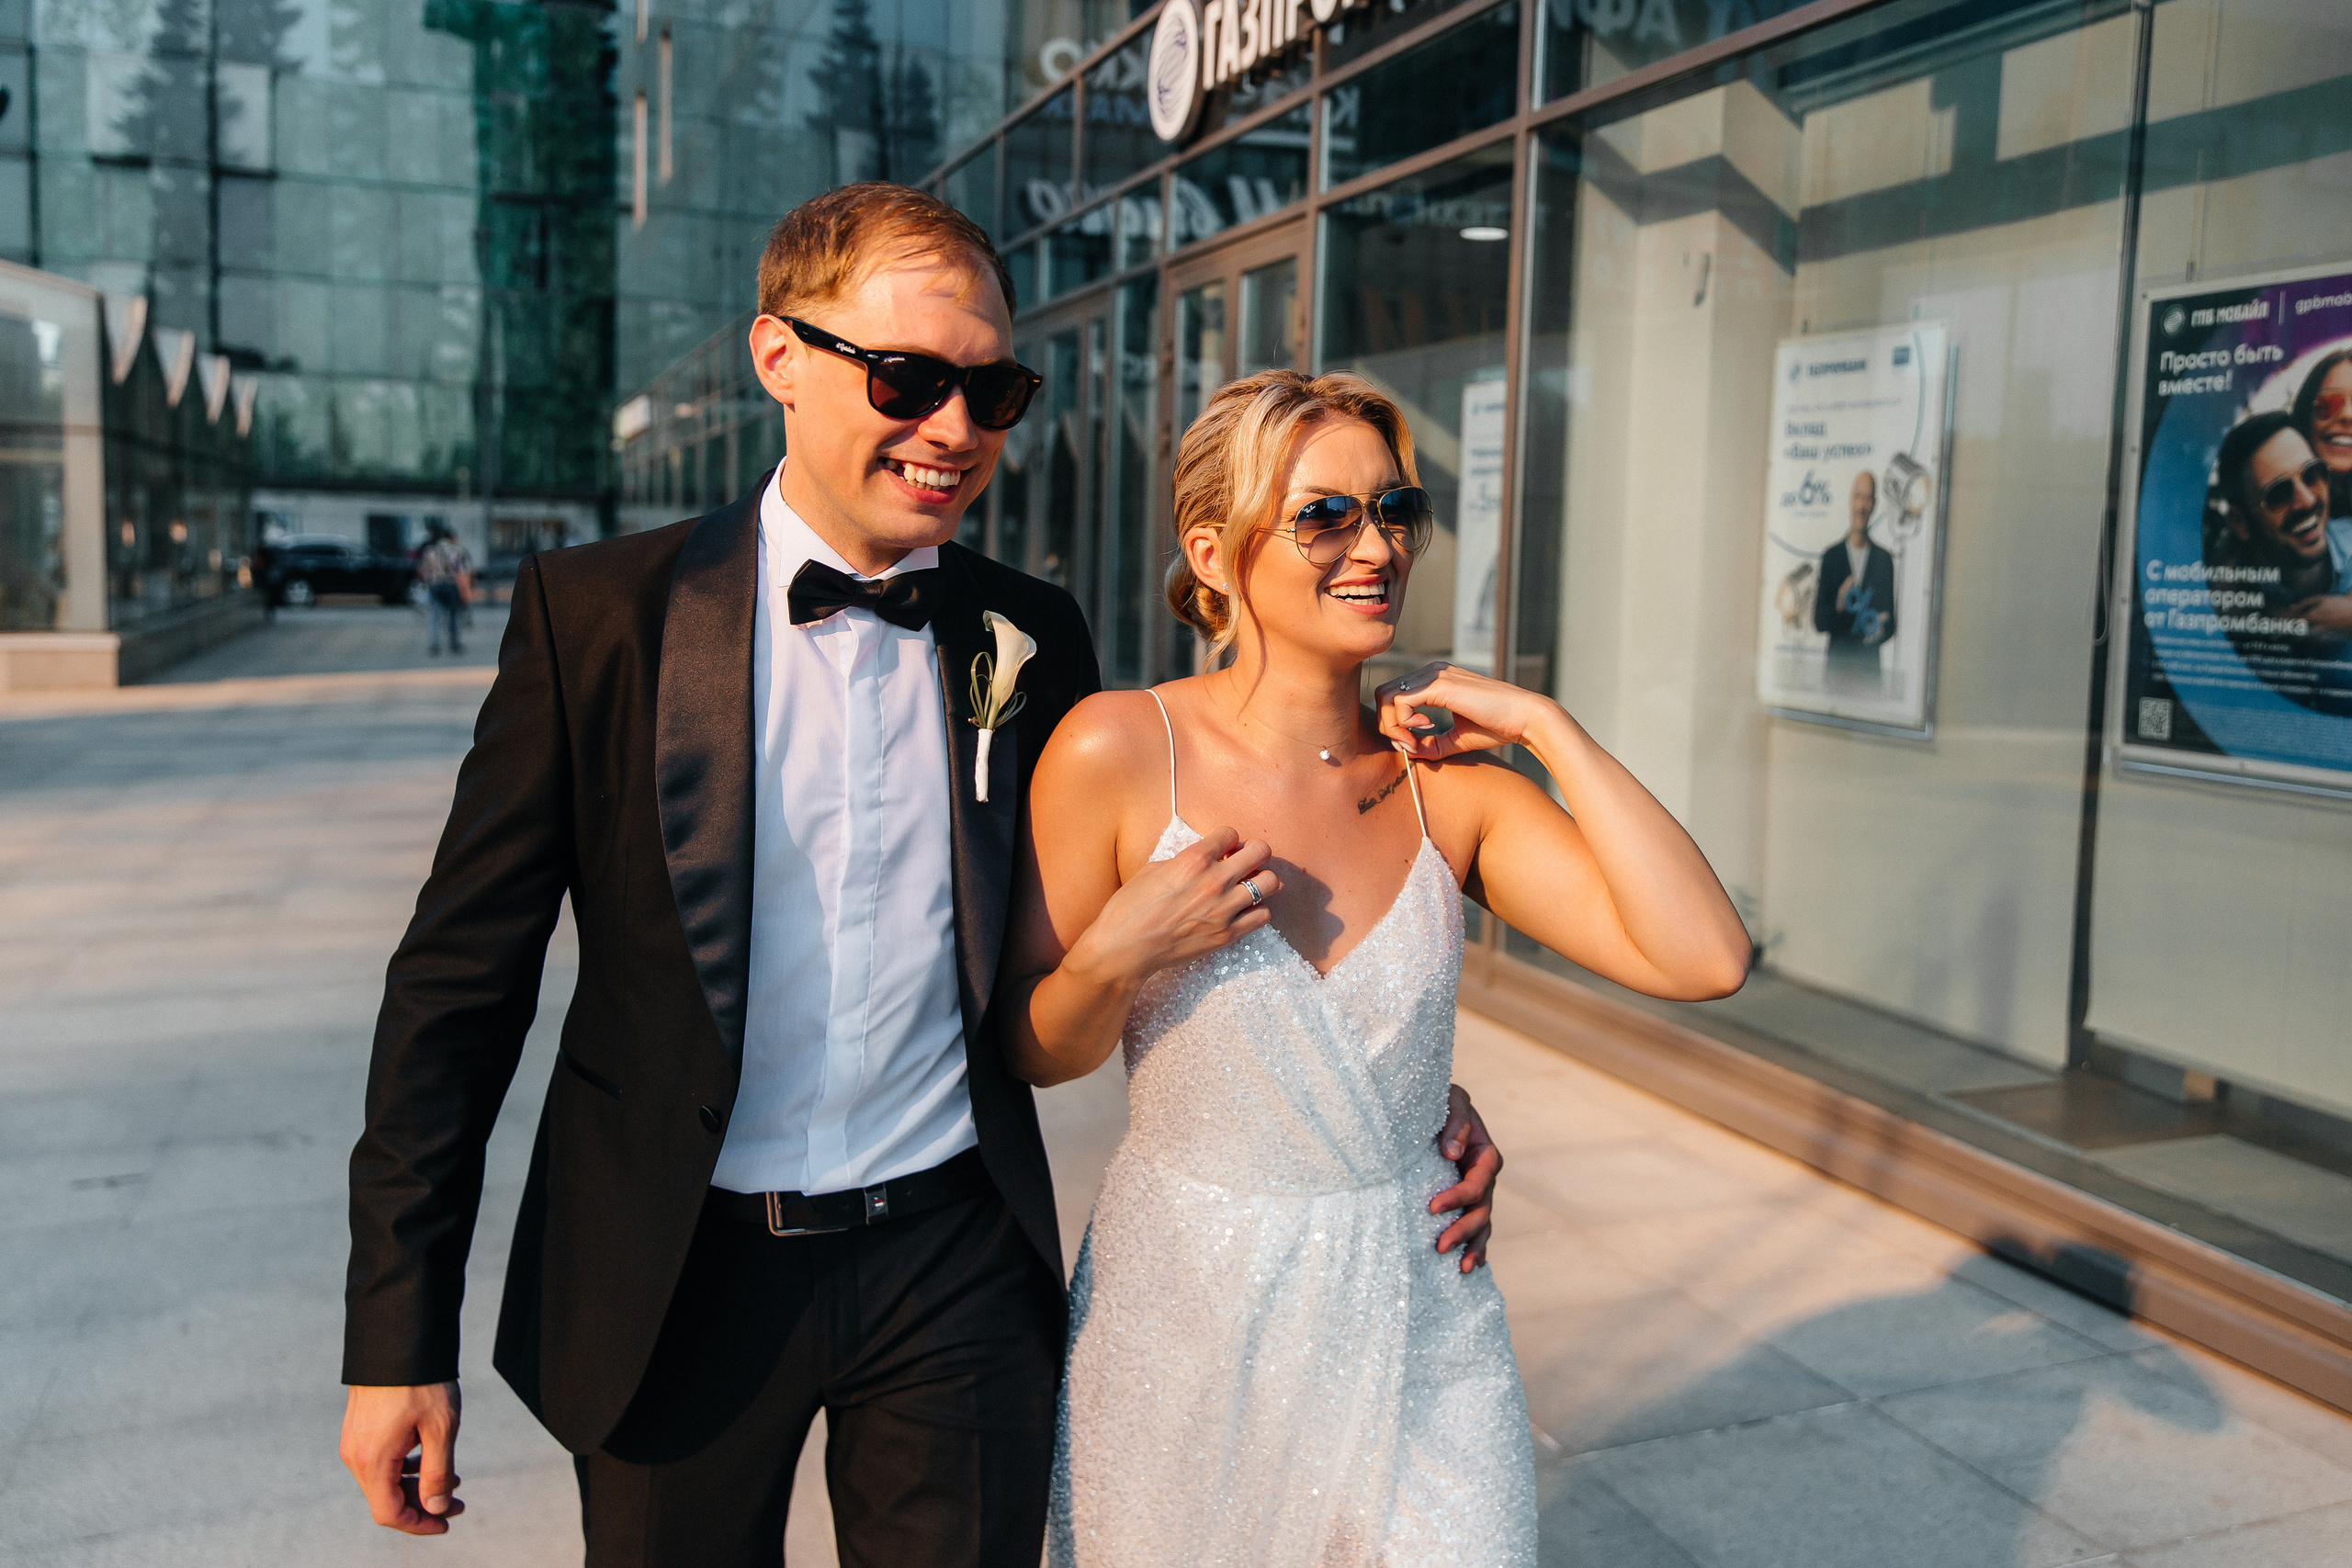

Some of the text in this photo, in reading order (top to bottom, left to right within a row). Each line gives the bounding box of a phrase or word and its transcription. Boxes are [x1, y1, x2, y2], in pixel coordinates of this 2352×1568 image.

[2160, 343, 2285, 376] Просто быть
[2158, 369, 2233, 396] вместе!
[2145, 558, 2281, 584] С мобильным
[2144, 587, 2265, 612] оператором
[2143, 607, 2309, 637] от Газпромбанка
